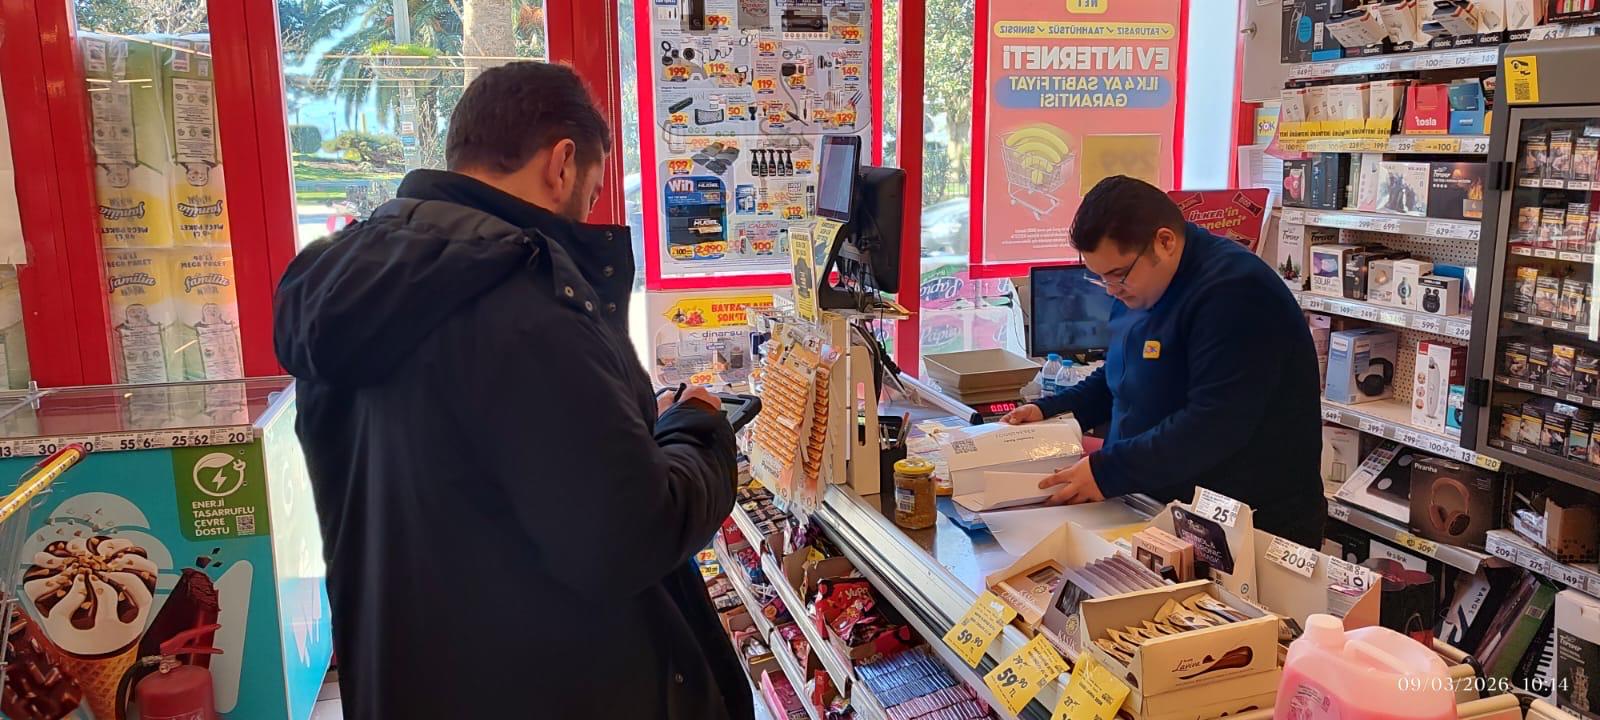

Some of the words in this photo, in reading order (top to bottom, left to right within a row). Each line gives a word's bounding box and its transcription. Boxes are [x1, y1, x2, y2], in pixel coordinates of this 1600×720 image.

[668, 66, 687, 77] 199
[709, 63, 726, 72] 119
[841, 67, 858, 76] 149
[756, 79, 773, 88] 119
[1414, 115, 1437, 127] tosla
[1421, 320, 1435, 330] 599
[1455, 327, 1470, 337] 249
[38, 443, 57, 455] 30
[120, 439, 136, 450] 55
[171, 435, 188, 446] 25
[194, 434, 210, 446] 62
[228, 432, 246, 444] 20
[1462, 451, 1472, 462] 13
[1414, 462, 1439, 474] Piranha
[192, 497, 225, 510] ENERJİ
[192, 506, 255, 519] TASARRUFLU
[1212, 506, 1230, 523] 25
[194, 517, 226, 530] ÇEVRE
[195, 526, 231, 538] DOSTU
[1495, 546, 1511, 558] 209
[1529, 560, 1544, 572] 275
[1563, 573, 1578, 586] 149
